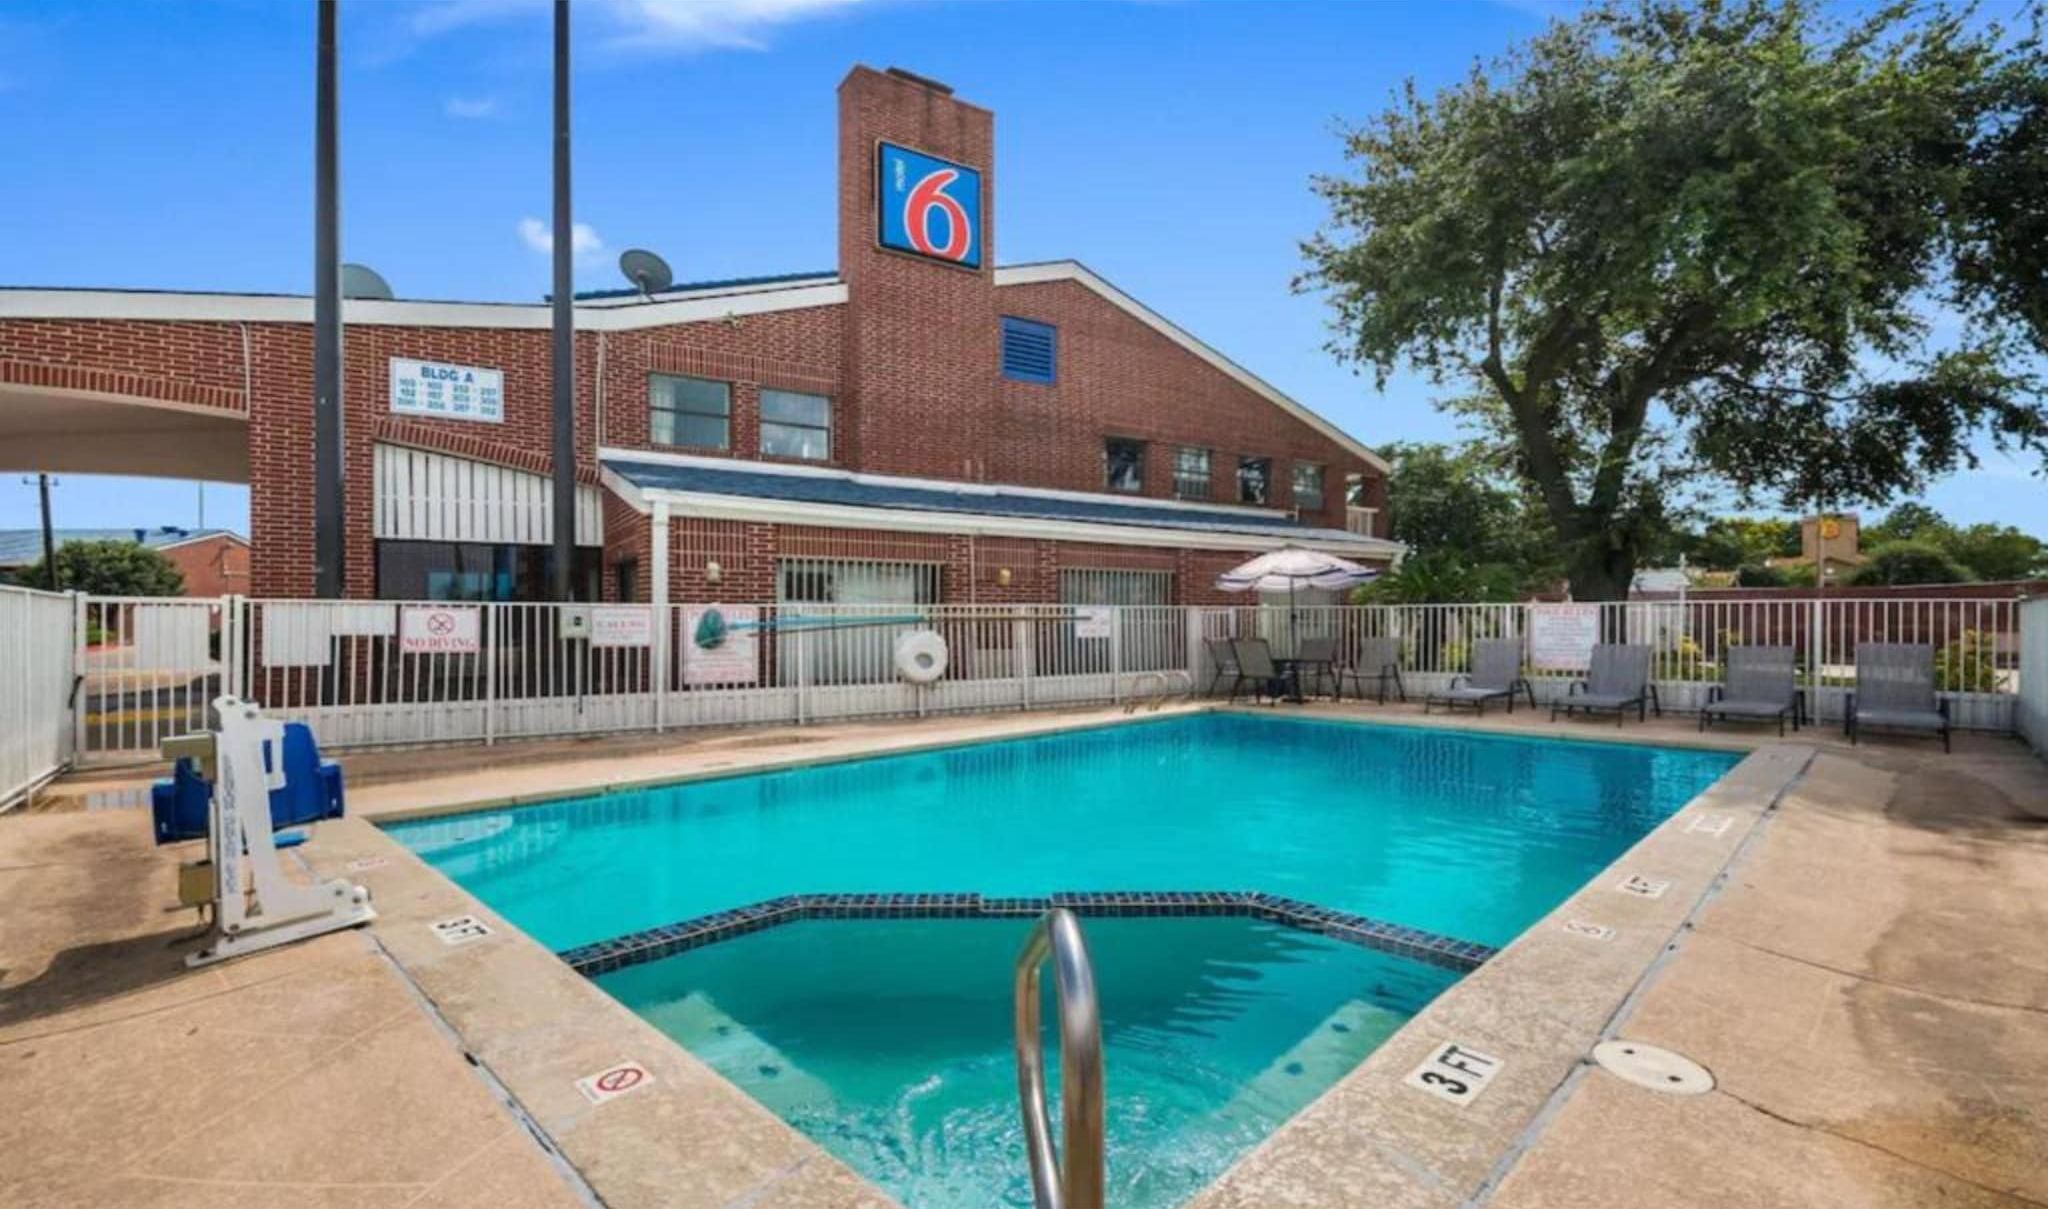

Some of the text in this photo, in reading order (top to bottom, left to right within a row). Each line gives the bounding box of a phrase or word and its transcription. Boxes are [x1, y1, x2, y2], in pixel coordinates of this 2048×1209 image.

[903, 168, 971, 261] 6
[420, 365, 474, 383] BLDG A
[405, 637, 475, 648] NO DIVING
[1421, 1044, 1495, 1096] 3 FT
